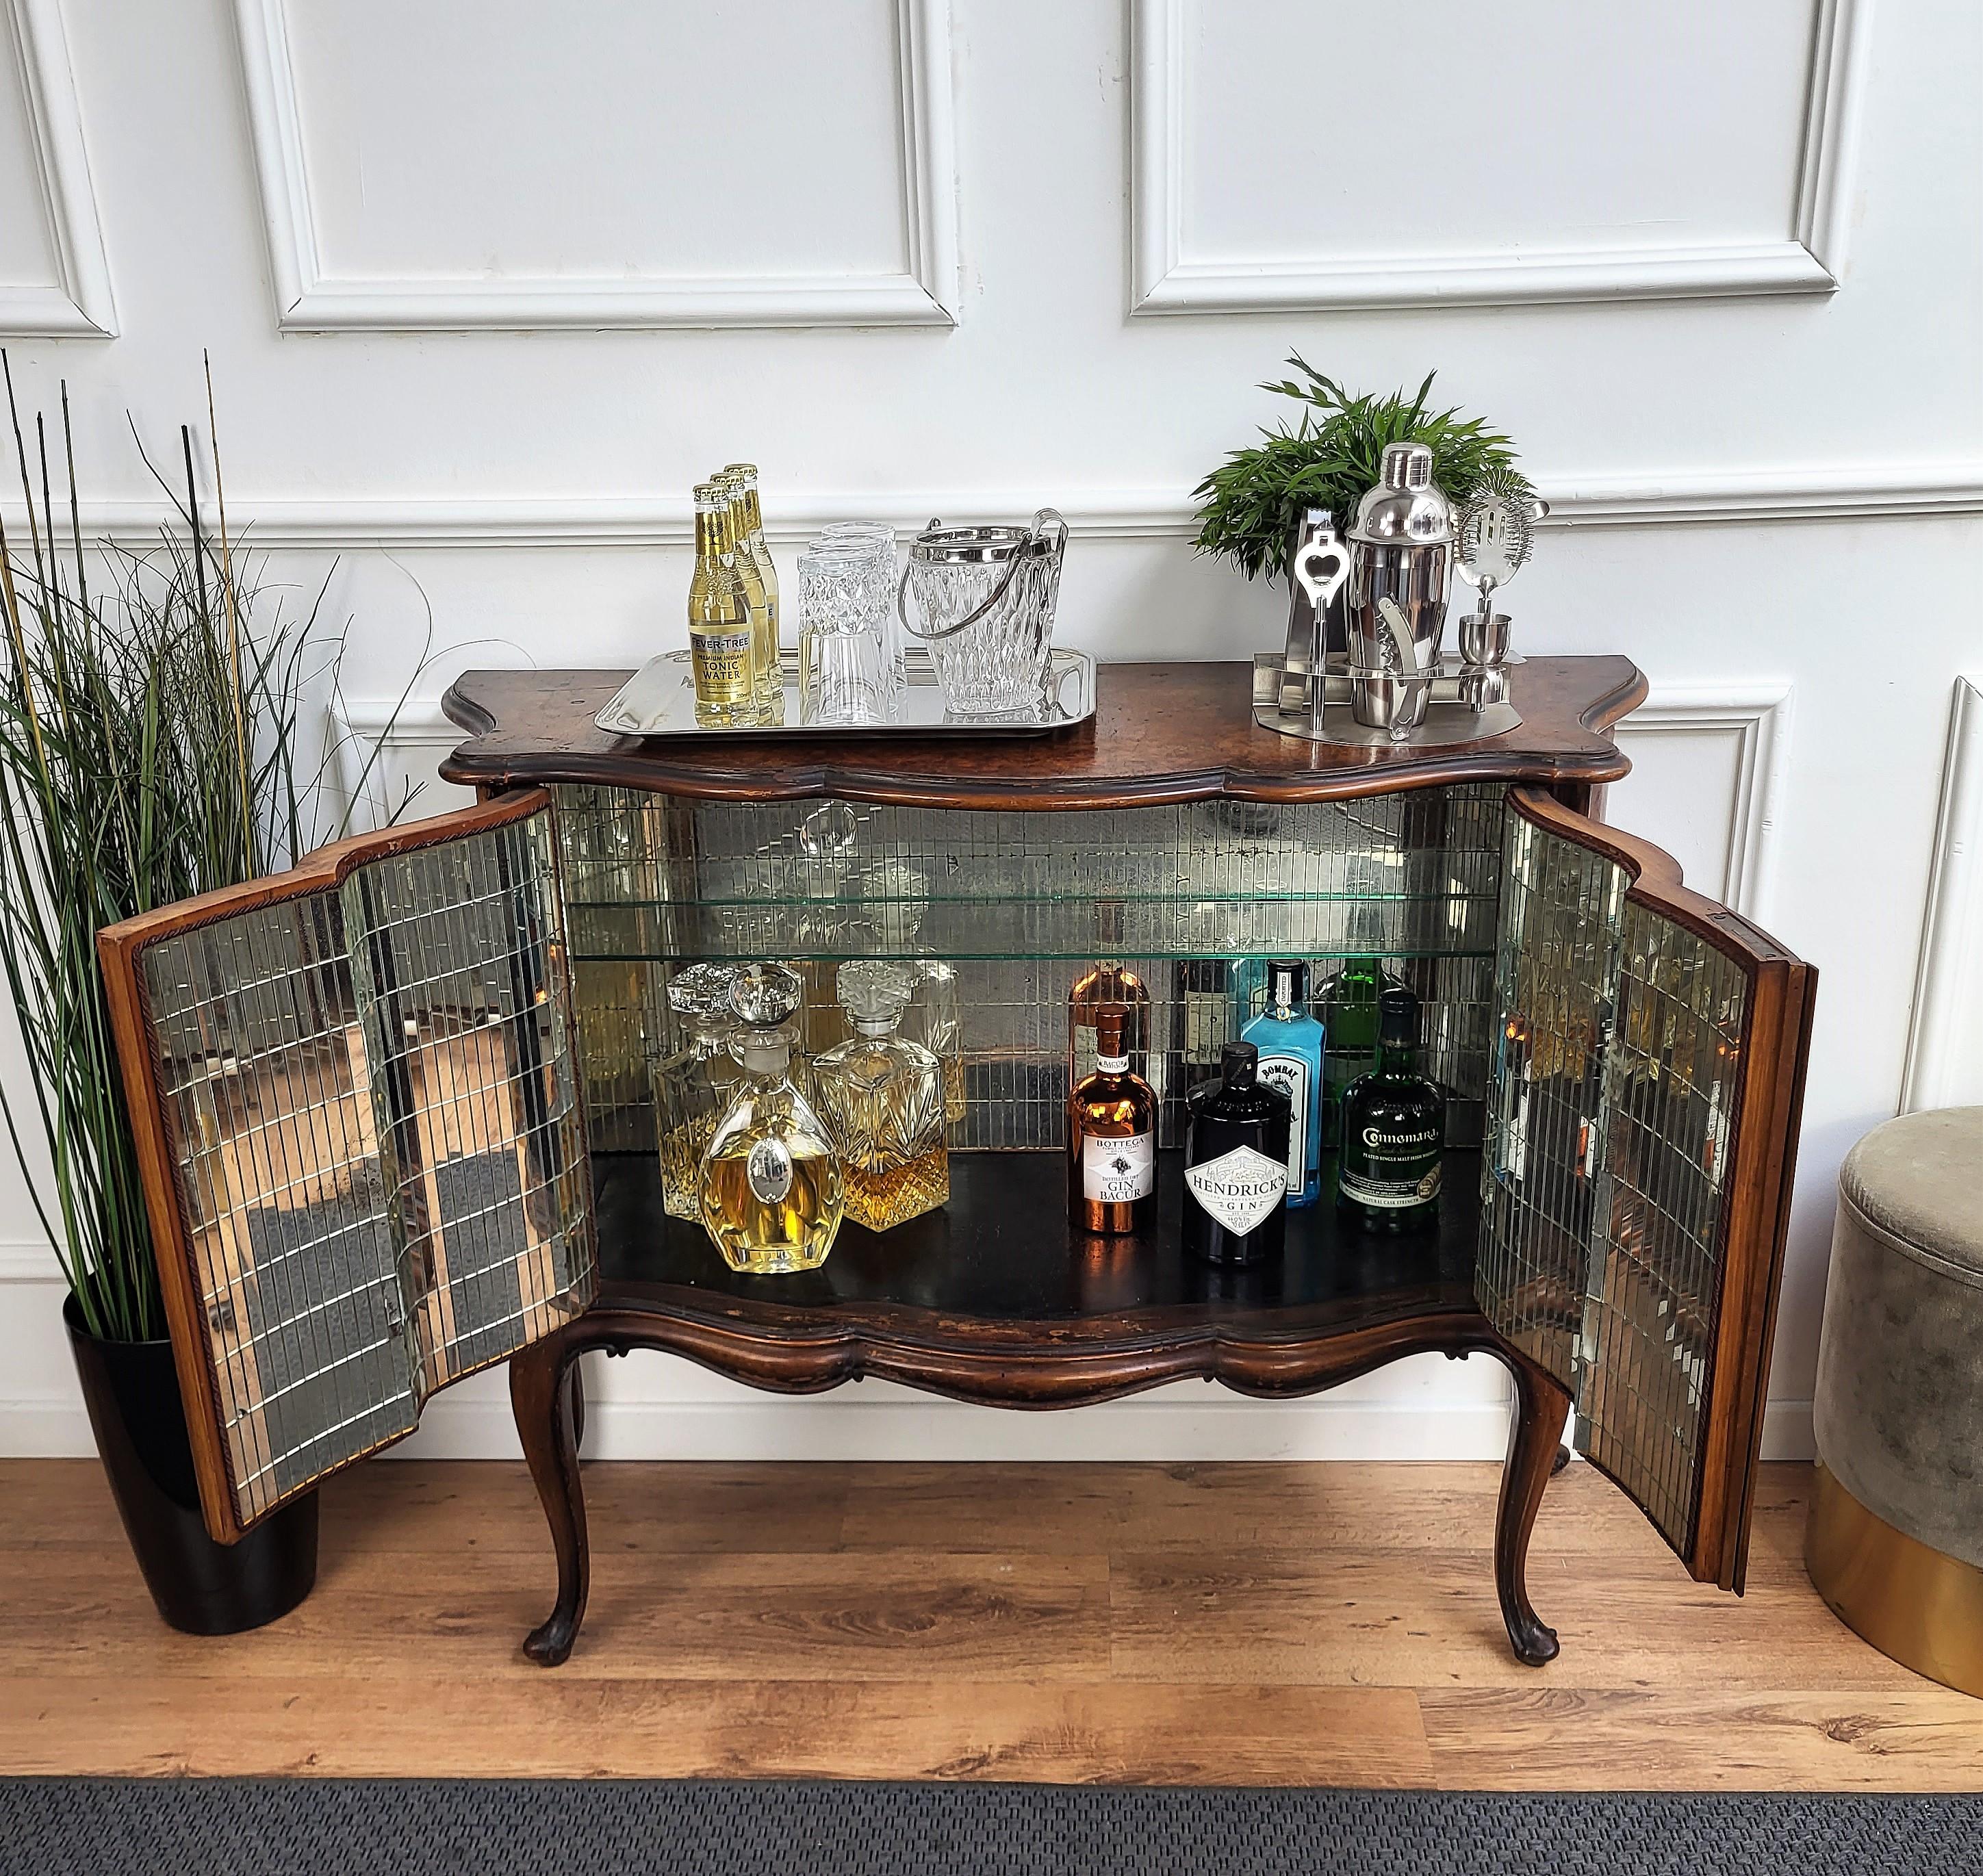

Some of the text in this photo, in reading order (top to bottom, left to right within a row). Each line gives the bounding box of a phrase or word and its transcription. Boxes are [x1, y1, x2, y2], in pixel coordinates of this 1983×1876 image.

[691, 637, 749, 650] FEVER-TREE
[703, 661, 739, 671] TONIC
[702, 671, 741, 680] WATER
[1262, 1065, 1298, 1081] BOMBAY
[1097, 1137, 1144, 1148] BOTTEGA
[1108, 1180, 1134, 1192] GIN
[1193, 1173, 1285, 1196] HENDRICK'S
[1227, 1201, 1257, 1211] GIN
